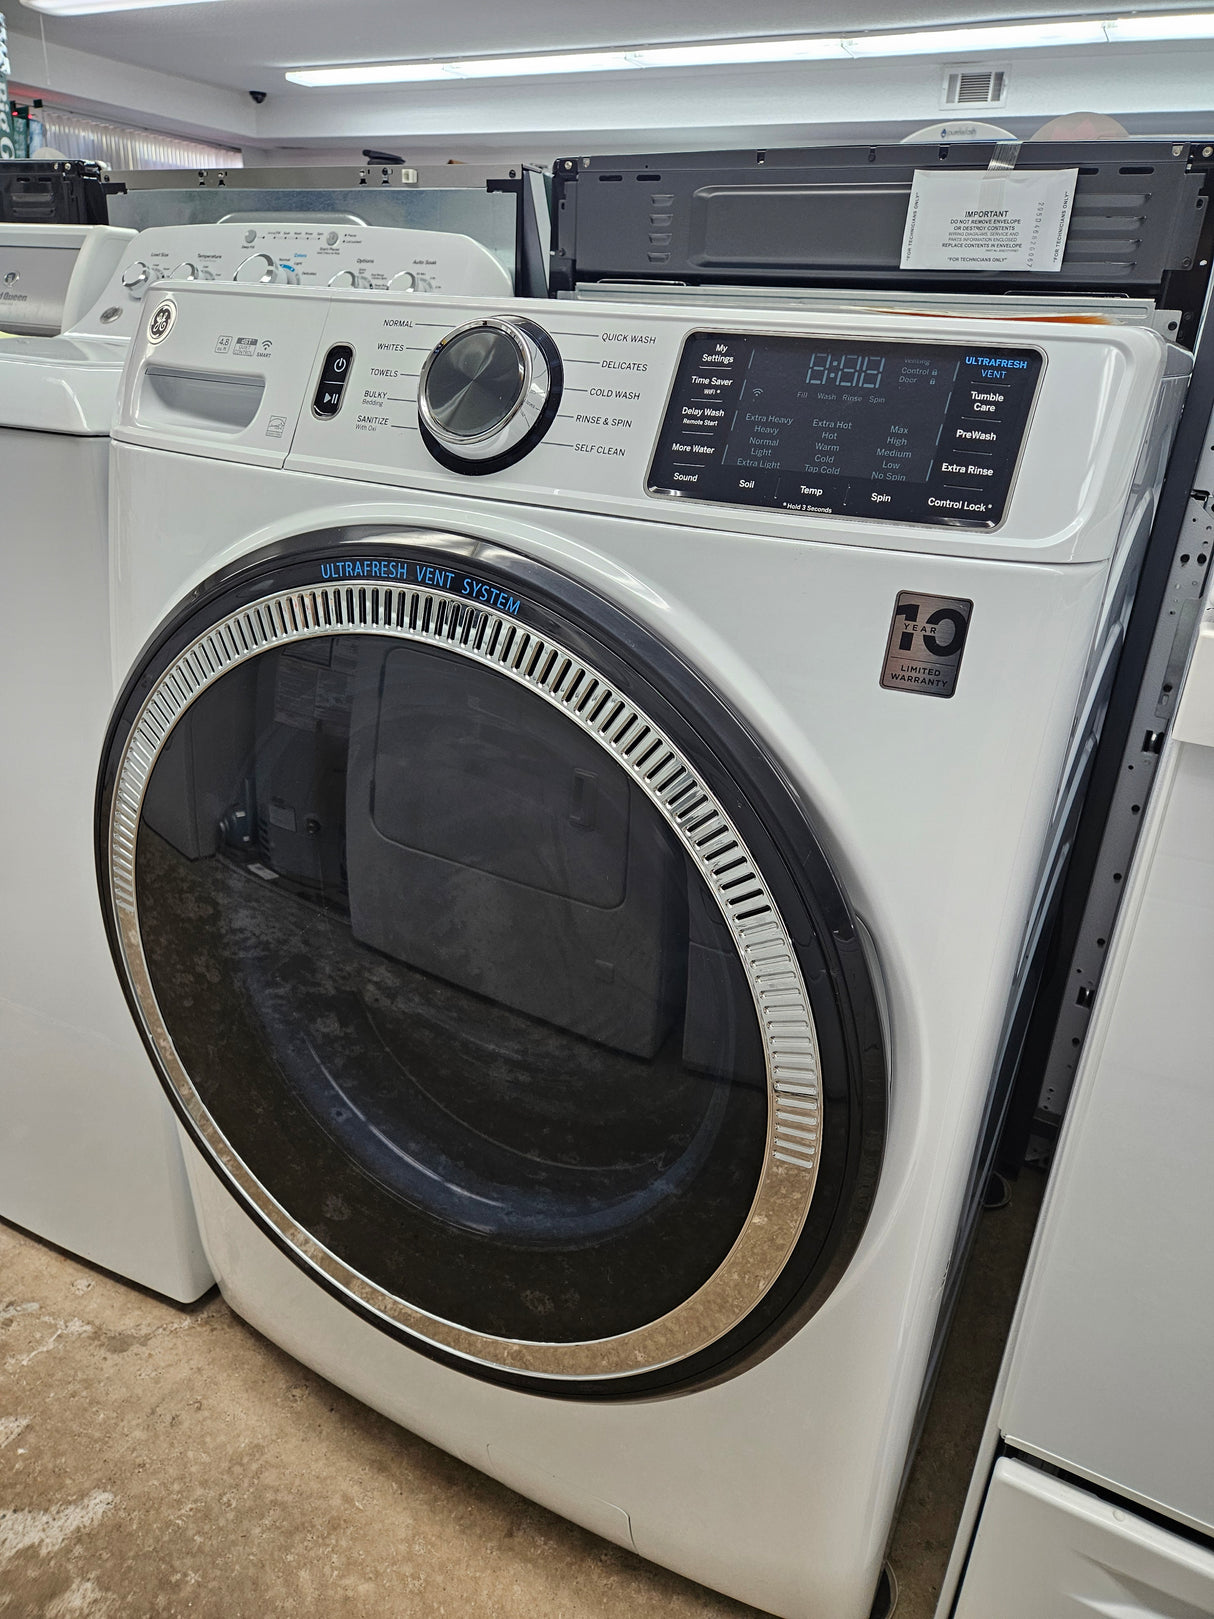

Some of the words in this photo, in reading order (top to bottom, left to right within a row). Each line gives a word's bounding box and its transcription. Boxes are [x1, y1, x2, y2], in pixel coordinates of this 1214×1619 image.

[964, 210, 1009, 218] IMPORTANT
[1056, 210, 1067, 247] TECHNICIANS
[3, 292, 28, 302] Queen
[383, 319, 413, 328] NORMAL
[219, 338, 230, 346] 4.8
[601, 332, 629, 344] QUICK
[630, 335, 657, 345] WASH
[377, 343, 405, 351] WHITES
[715, 344, 728, 353] My
[702, 353, 734, 364] Settings
[965, 356, 1028, 369] ULTRAFRESH
[601, 360, 648, 372] DELICATES
[901, 367, 929, 375] Control
[370, 368, 398, 378] TOWELS
[981, 370, 1007, 379] VENT
[691, 375, 710, 385] Time
[710, 377, 733, 386] Saver
[364, 390, 388, 399] BULKY
[589, 388, 613, 398] COLD
[615, 391, 641, 400] WASH
[817, 392, 837, 400] Wash
[842, 394, 863, 402] Rinse
[970, 391, 1004, 402] Tumble
[362, 399, 384, 407] Bedding
[869, 396, 886, 404] Spin
[681, 406, 703, 417] Delay
[704, 408, 725, 417] Wash
[973, 403, 996, 412] Care
[357, 415, 390, 426] SANITIZE
[575, 415, 601, 425] RINSE
[603, 417, 609, 426] &
[611, 418, 632, 428] SPIN
[745, 413, 767, 422] Extra
[768, 415, 794, 426] Heavy
[812, 419, 835, 428] Extra
[836, 421, 852, 430] Hot
[754, 425, 780, 436] Heavy
[890, 425, 909, 434] Max
[821, 431, 838, 440] Hot
[956, 429, 997, 442] PreWash
[749, 437, 780, 446] Normal
[815, 442, 840, 452] Warm
[886, 436, 908, 447] High
[574, 443, 596, 453] SELF
[596, 446, 626, 457] CLEAN
[671, 443, 691, 452] More
[692, 444, 715, 454] Water
[750, 447, 772, 458] Light
[876, 449, 912, 459] Medium
[737, 458, 758, 467] Extra
[759, 460, 781, 469] Light
[814, 454, 835, 463] Cold
[804, 464, 819, 473] Tap
[820, 466, 841, 475] Cold
[882, 460, 901, 469] Low
[941, 463, 966, 474] Extra
[968, 466, 994, 476] Rinse
[673, 472, 698, 482] Sound
[871, 471, 885, 480] No
[886, 473, 906, 482] Spin
[739, 479, 755, 489] Soil
[800, 485, 823, 496] Temp
[871, 492, 892, 504] Spin
[806, 505, 832, 514] Seconds
[928, 497, 962, 509] Control
[964, 501, 986, 512] Lock
[320, 561, 408, 579] ULTRAFRESH
[416, 565, 455, 589] VENT
[461, 578, 521, 615] SYSTEM
[896, 603, 968, 657] 10
[904, 622, 937, 634] YEAR
[900, 664, 941, 677] LIMITED
[891, 673, 949, 688] WARRANTY
